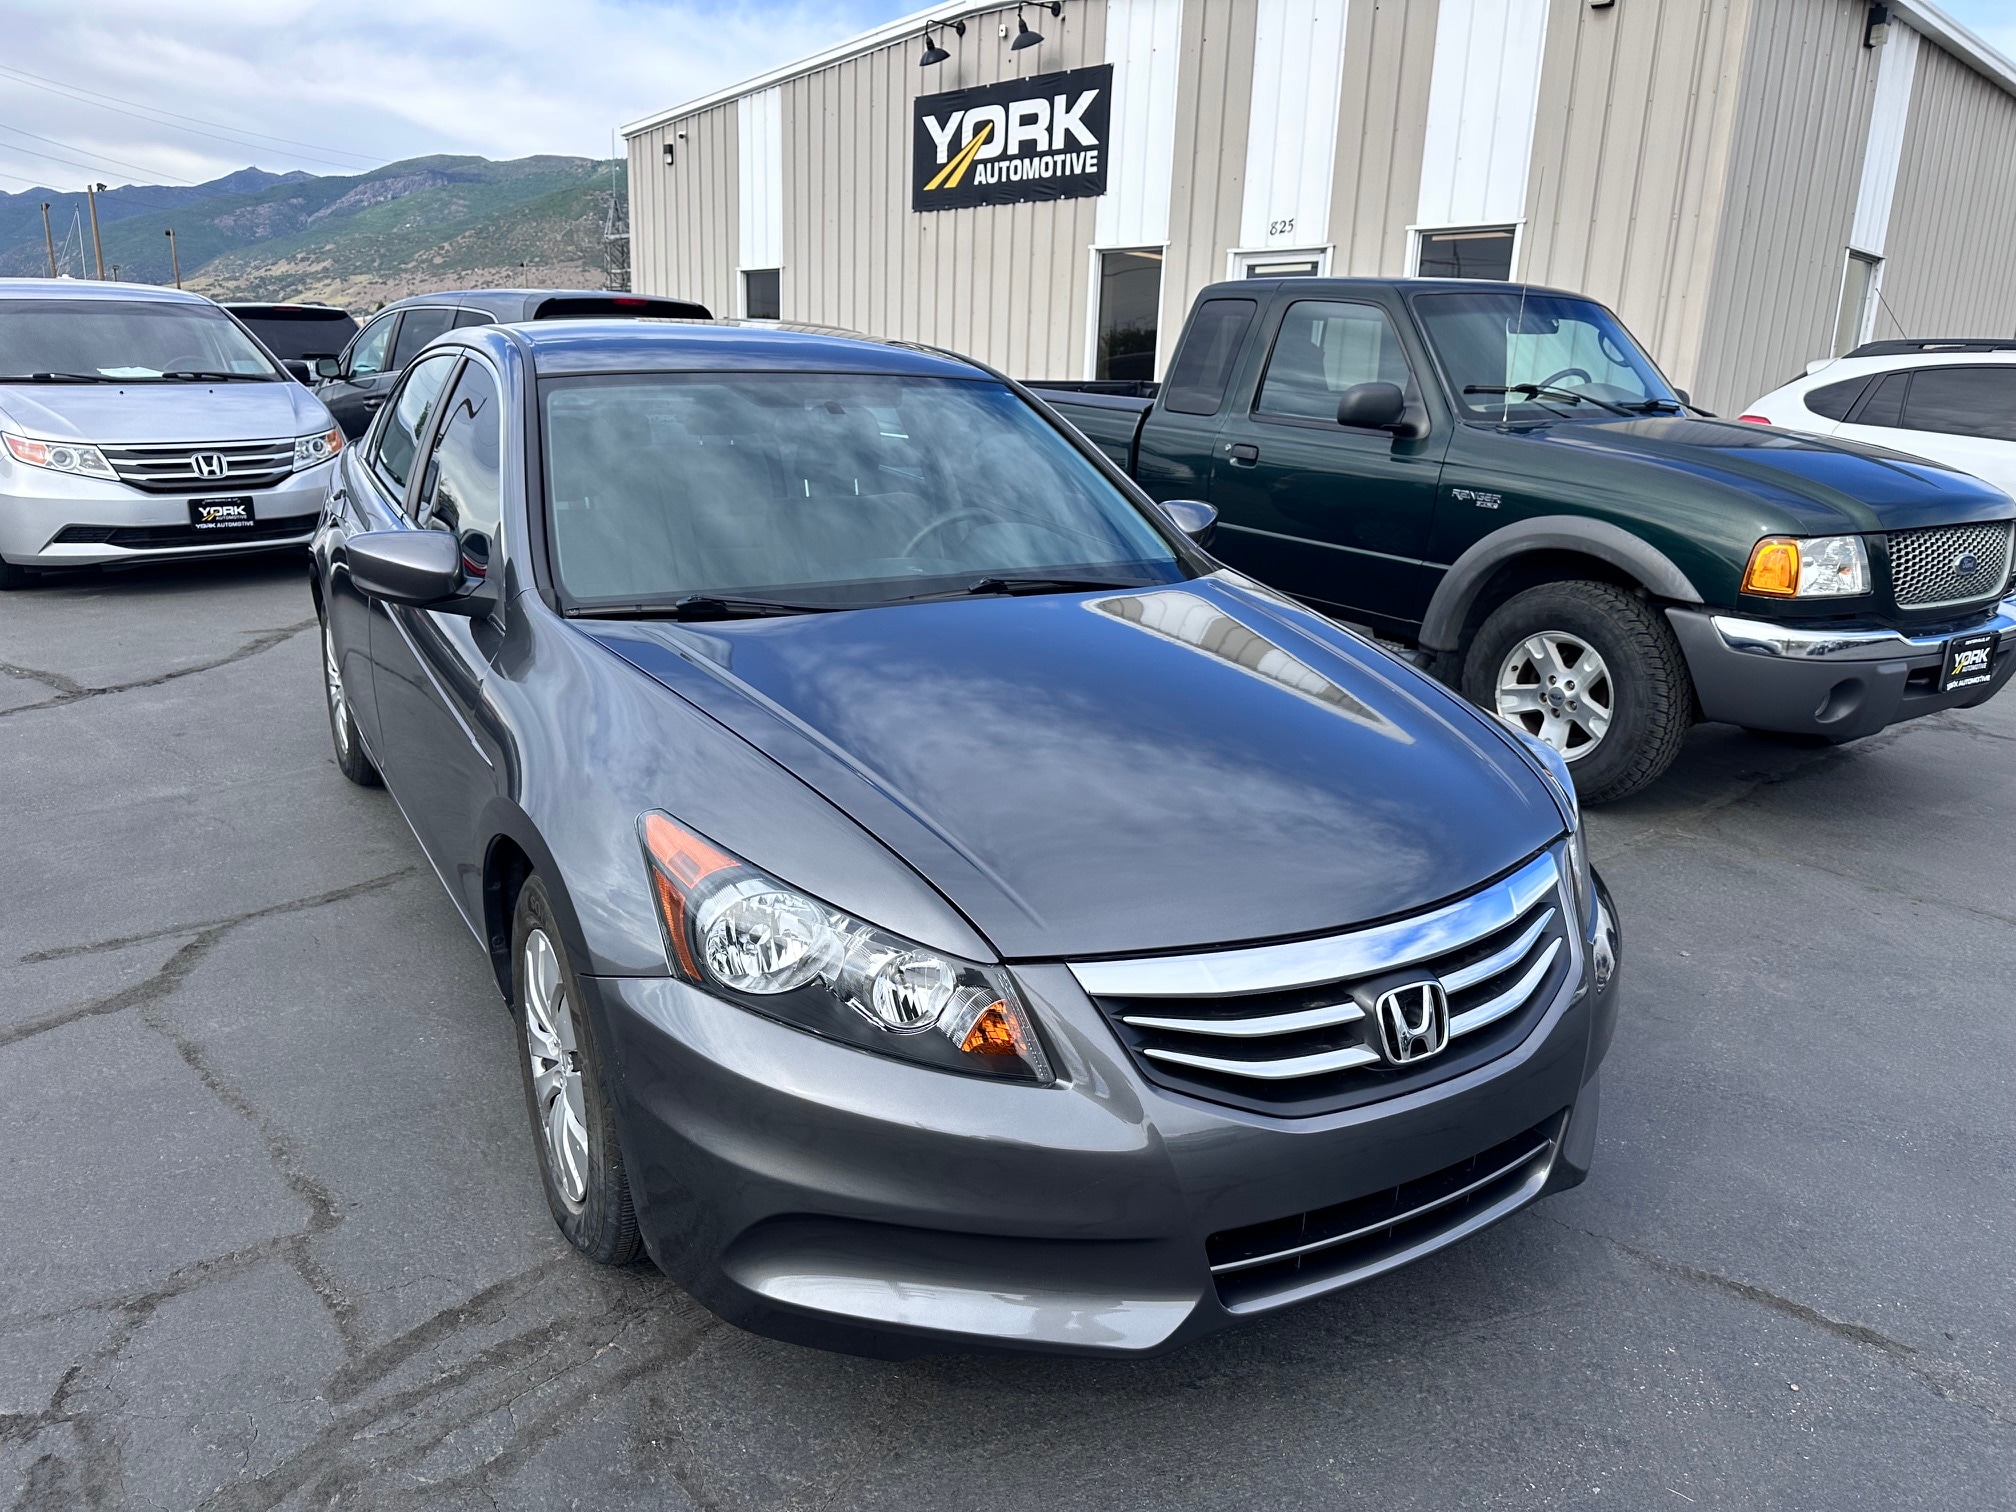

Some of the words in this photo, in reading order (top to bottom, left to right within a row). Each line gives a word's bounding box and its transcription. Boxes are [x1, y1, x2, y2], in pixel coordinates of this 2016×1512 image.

[922, 89, 1100, 164] YORK
[974, 150, 1099, 185] AUTOMOTIVE
[1269, 218, 1294, 235] 825
[1451, 488, 1502, 503] RANGER
[198, 505, 246, 516] YORK
[217, 520, 254, 528] AUTOMOTIVE
[1954, 647, 1990, 668] YORK
